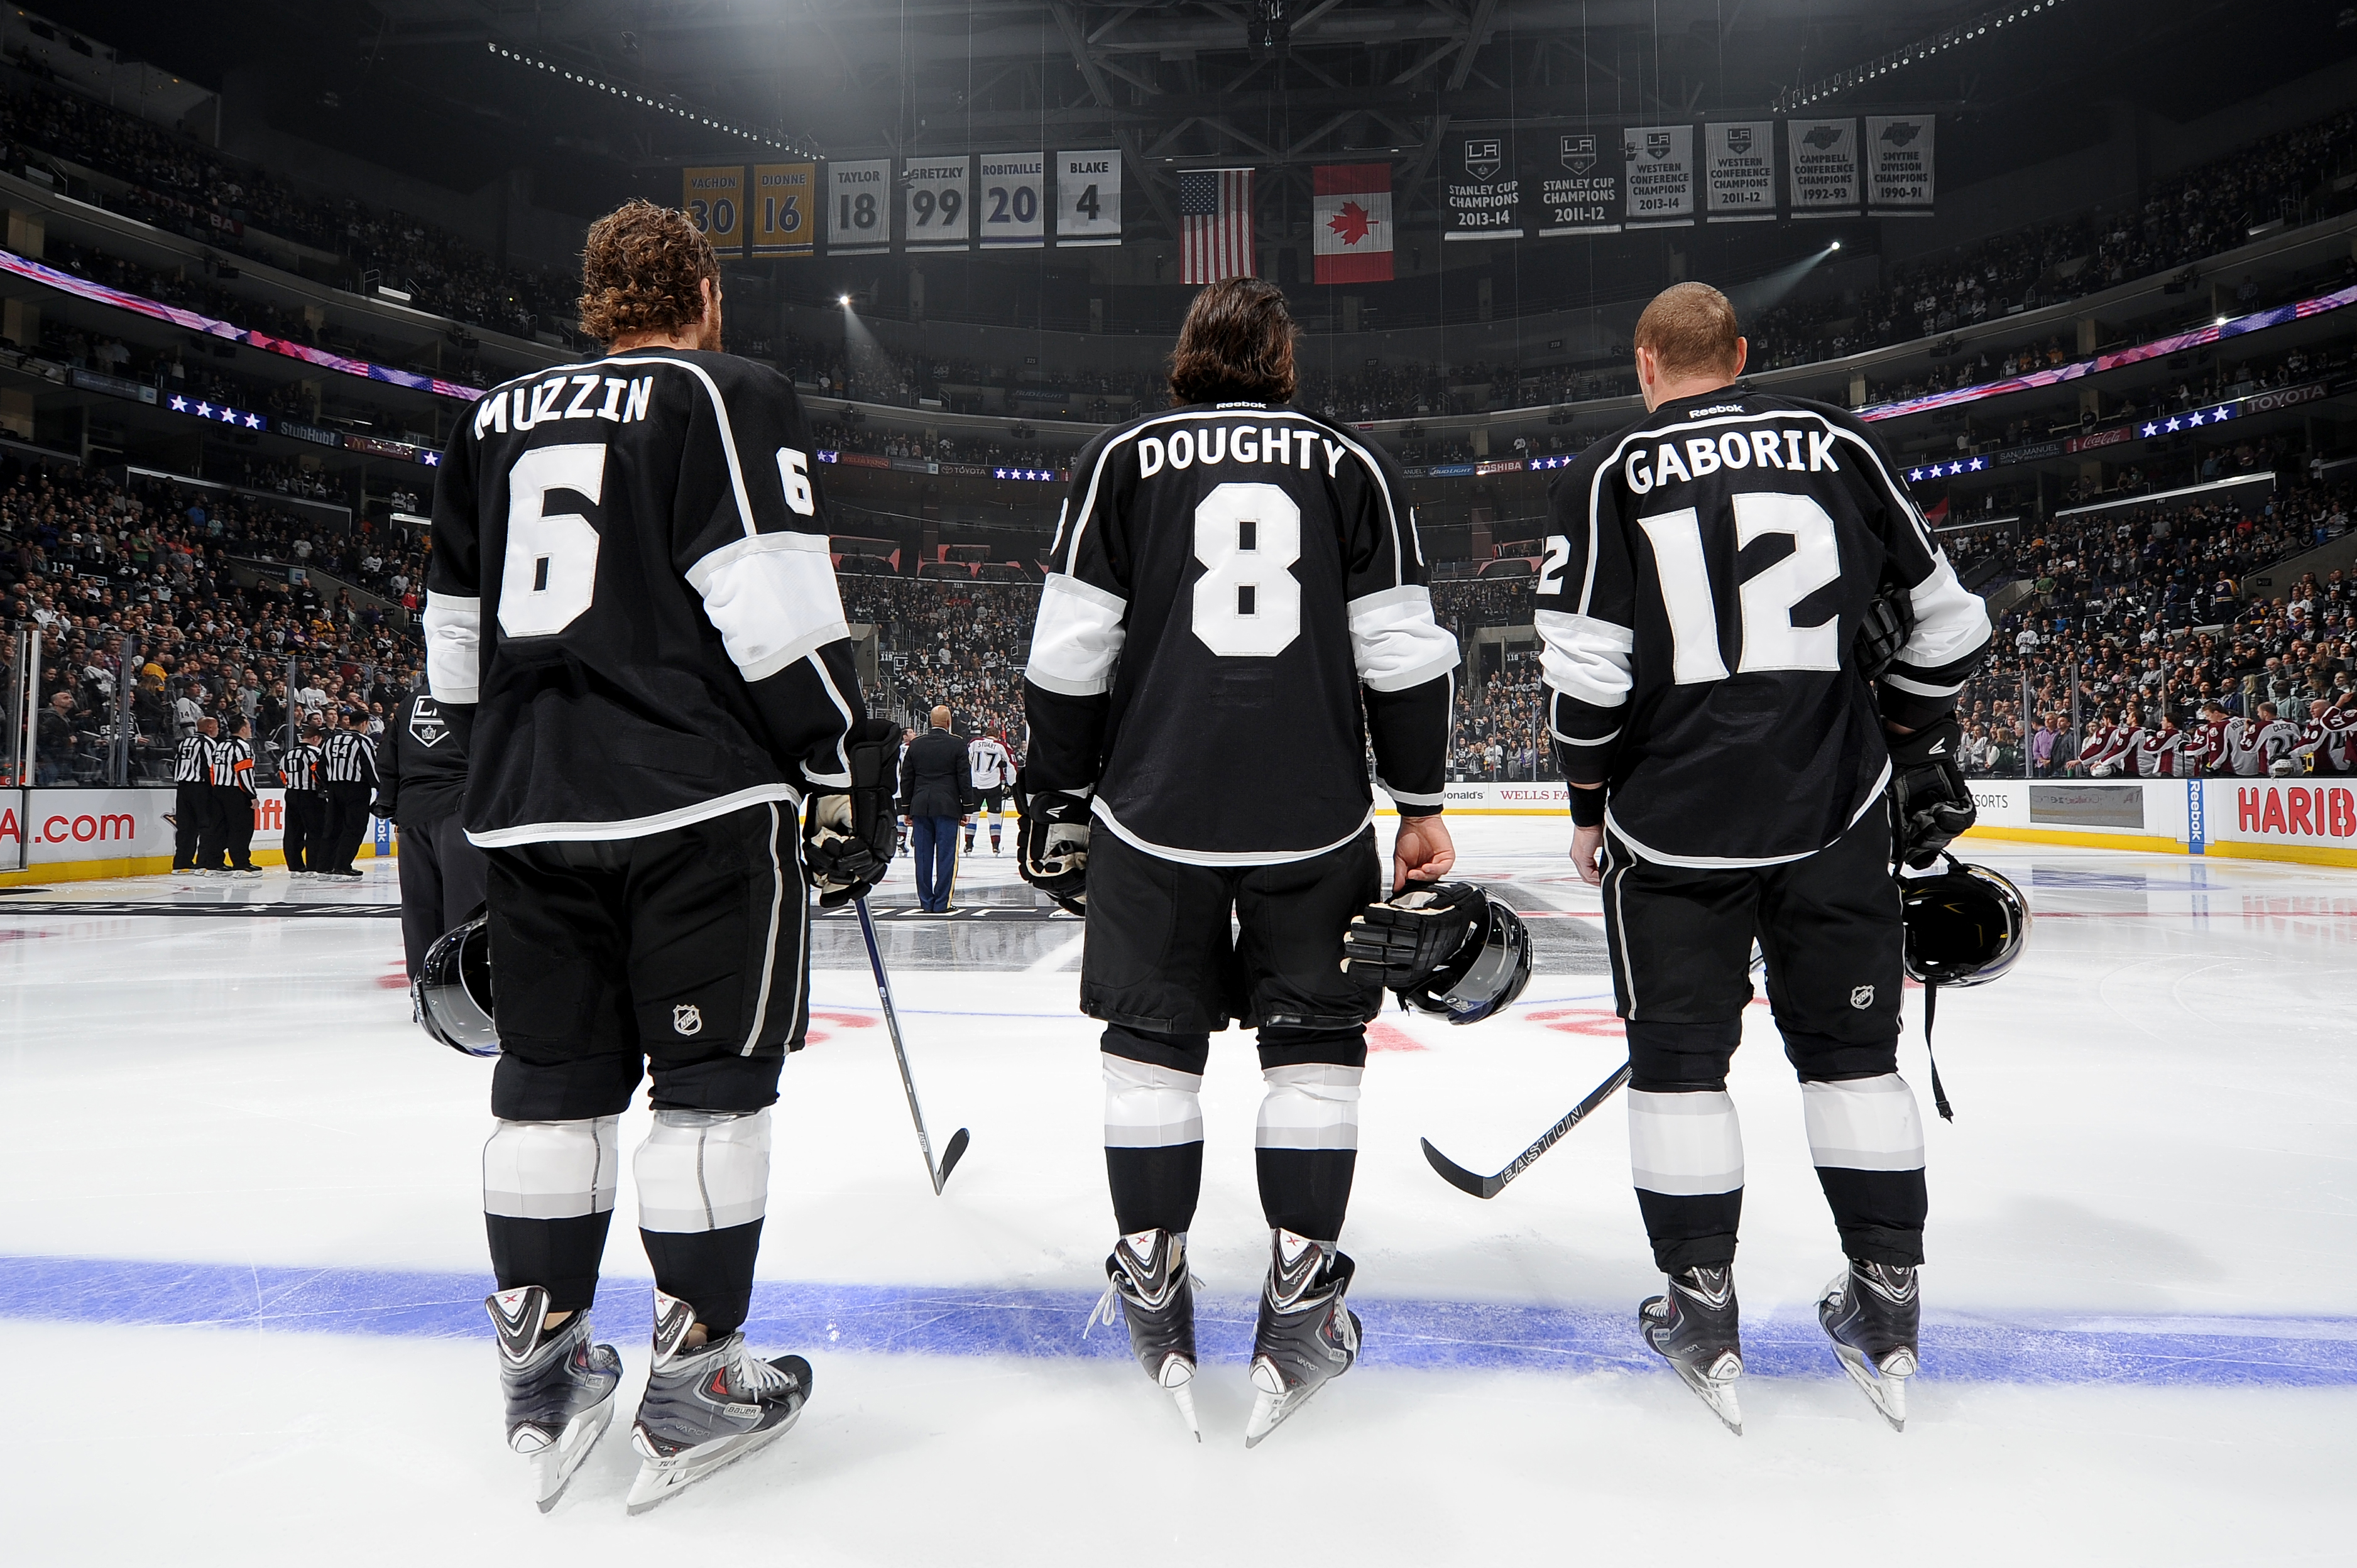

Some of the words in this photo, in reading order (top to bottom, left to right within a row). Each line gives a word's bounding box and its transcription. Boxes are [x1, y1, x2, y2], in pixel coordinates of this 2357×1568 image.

[1648, 134, 1669, 144] LA
[1729, 129, 1750, 139] LA
[1468, 144, 1498, 157] LA
[1564, 139, 1593, 152] LA
[1717, 157, 1763, 167] WESTERN
[1800, 154, 1848, 163] CAMPBELL
[1883, 151, 1918, 161] SMYTHE
[911, 166, 964, 179] GRETZKY
[982, 163, 1041, 175] ROBITAILLE
[1069, 161, 1109, 174] BLAKE
[1636, 163, 1681, 173] WESTERN
[1710, 168, 1770, 178] CONFERENCE
[1794, 164, 1854, 175] CONFERENCE
[1881, 163, 1922, 172] DIVISION
[691, 177, 736, 188] VACHON
[762, 174, 806, 187] DIONNE
[838, 171, 880, 183] TAYLOR
[1630, 173, 1689, 184] CONFERENCE
[1714, 178, 1768, 188] CHAMPIONS
[1798, 174, 1852, 185] CHAMPIONS
[1874, 173, 1928, 183] CHAMPIONS
[1449, 185, 1494, 195] STANLEY
[1497, 180, 1518, 193] CUP
[1543, 179, 1589, 191] STANLEY
[1593, 177, 1615, 188] CUP
[1632, 185, 1686, 195] CHAMPIONS
[1543, 190, 1616, 204] CHAMPIONS
[1722, 192, 1761, 204] 2011-12
[1803, 188, 1847, 199] 1992-93
[1880, 187, 1922, 198] 1990-91
[987, 186, 1037, 223] 20
[1076, 184, 1100, 221] 4
[1449, 193, 1519, 208] CHAMPIONS
[1639, 198, 1680, 210] 2013-14
[840, 193, 877, 230] 18
[912, 189, 962, 226] 99
[1555, 206, 1605, 222] 2011-12
[690, 197, 735, 235] 30
[765, 196, 802, 233] 16
[1458, 210, 1510, 226] 2013-14
[1015, 390, 1041, 398] BUD
[2247, 385, 2326, 411] TOYOTA
[474, 374, 653, 440] MUZZIN
[1217, 401, 1267, 410] Reebok
[1689, 404, 1744, 418] Reebok
[281, 422, 336, 446] StubHub!
[1138, 425, 1346, 479] DOUGHTY
[2000, 451, 2018, 460] SAN
[2023, 444, 2059, 455] MANUEL
[841, 455, 867, 465] WELLS
[867, 458, 890, 468] FARGO
[1477, 462, 1522, 472] TOSHIBA
[1626, 430, 1840, 494] GABORIK
[954, 467, 986, 476] TOYOTA
[776, 447, 814, 516] 6
[498, 444, 606, 638] 6
[1191, 482, 1301, 657] 8
[1636, 493, 1841, 685] 12
[2194, 735, 2205, 744] 22
[2305, 730, 2319, 739] 40
[978, 742, 997, 750] STUART
[2116, 738, 2124, 746] 8
[2149, 739, 2157, 748] 4
[2211, 742, 2217, 751] 2
[182, 746, 192, 759] 57
[332, 744, 346, 758] 94
[214, 752, 226, 764] 24
[288, 758, 297, 771] 11
[975, 751, 999, 773] 17
[5, 777, 11, 785] G
[1500, 790, 1550, 800] WELLS
[1972, 794, 2008, 808] SORTS
[2190, 781, 2202, 841] Reebok
[2238, 787, 2357, 837] HARIB
[679, 1011, 697, 1029] NHL
[918, 1131, 928, 1153] EASTON
[1501, 1104, 1585, 1187] EASTON
[1122, 1253, 1144, 1283] VAPOR
[1289, 1258, 1315, 1285] VAPOR
[664, 1314, 684, 1343] VAPOR
[1296, 1356, 1319, 1372] VAPOR
[728, 1407, 757, 1417] BAUER
[675, 1424, 711, 1438] VAPOR
